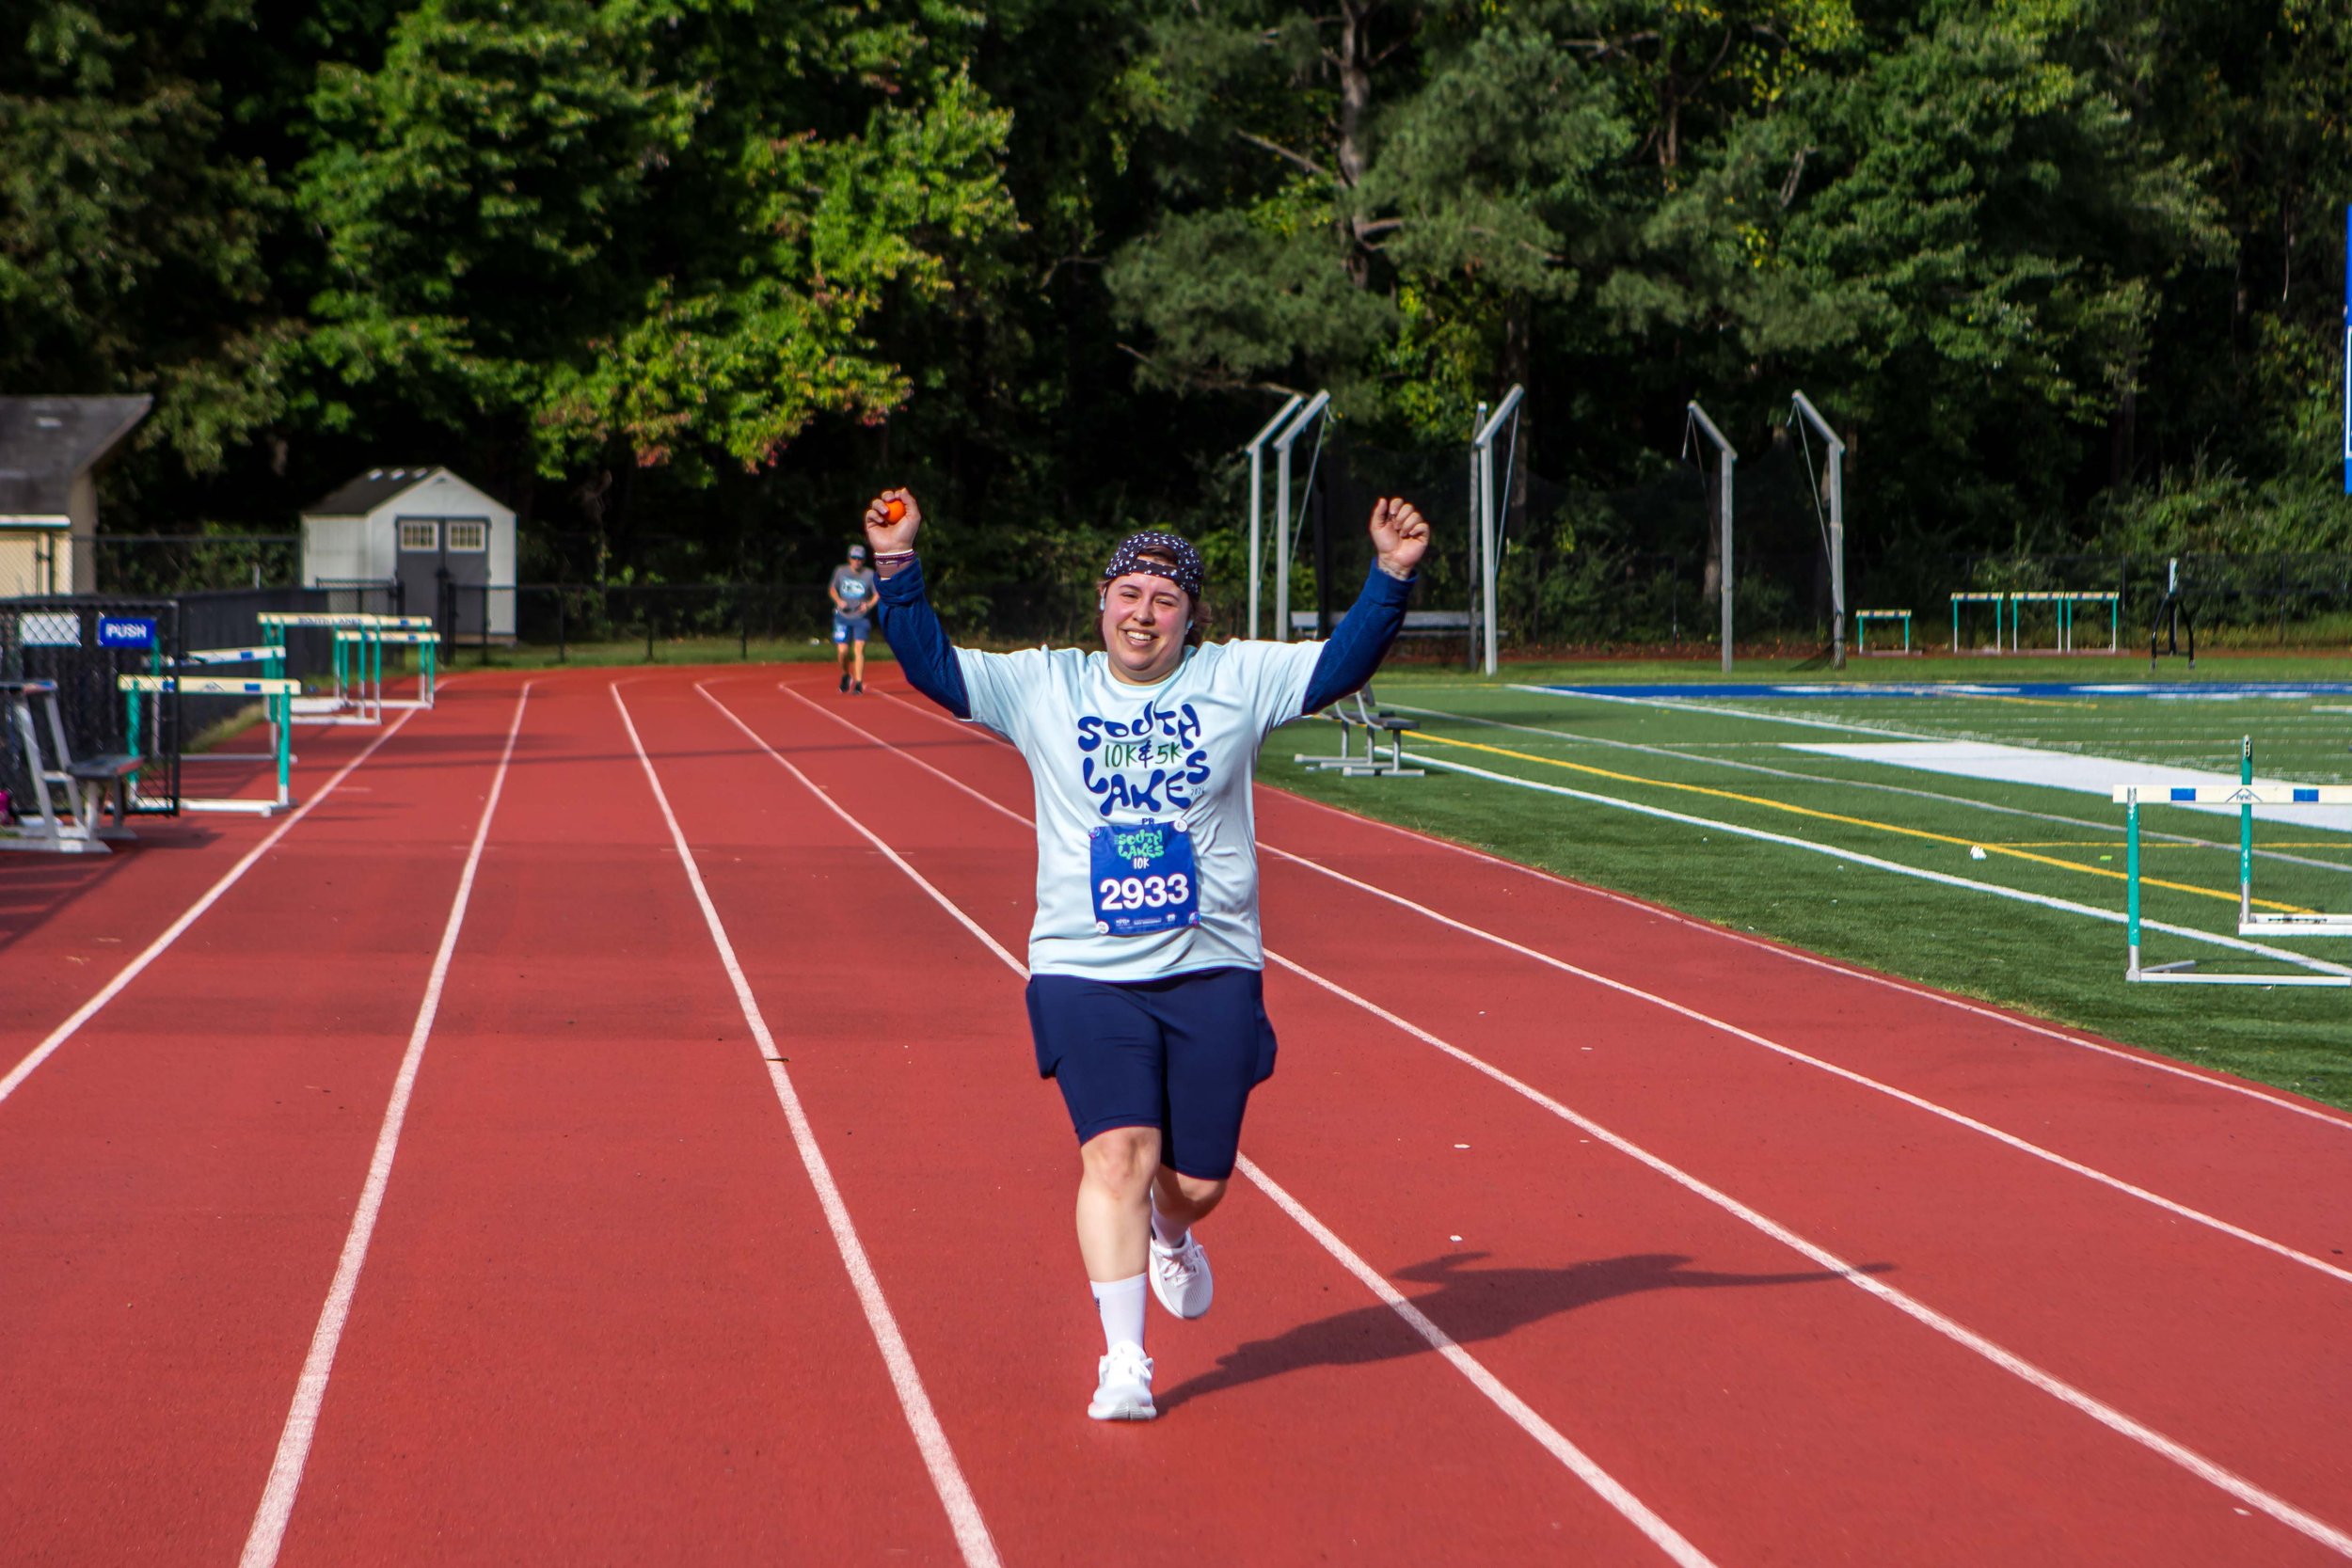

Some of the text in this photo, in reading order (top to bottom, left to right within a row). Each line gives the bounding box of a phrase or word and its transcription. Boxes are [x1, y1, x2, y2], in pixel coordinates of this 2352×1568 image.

[105, 624, 147, 639] PUSH
[1078, 701, 1200, 752] SOUTH
[1105, 744, 1137, 768] 10K
[1154, 742, 1183, 764] 5K
[1083, 750, 1211, 816] LAKES
[1119, 829, 1163, 846] SOUTH
[1119, 843, 1165, 860] LAKES
[1134, 857, 1150, 869] 10K
[1100, 873, 1189, 911] 2933
